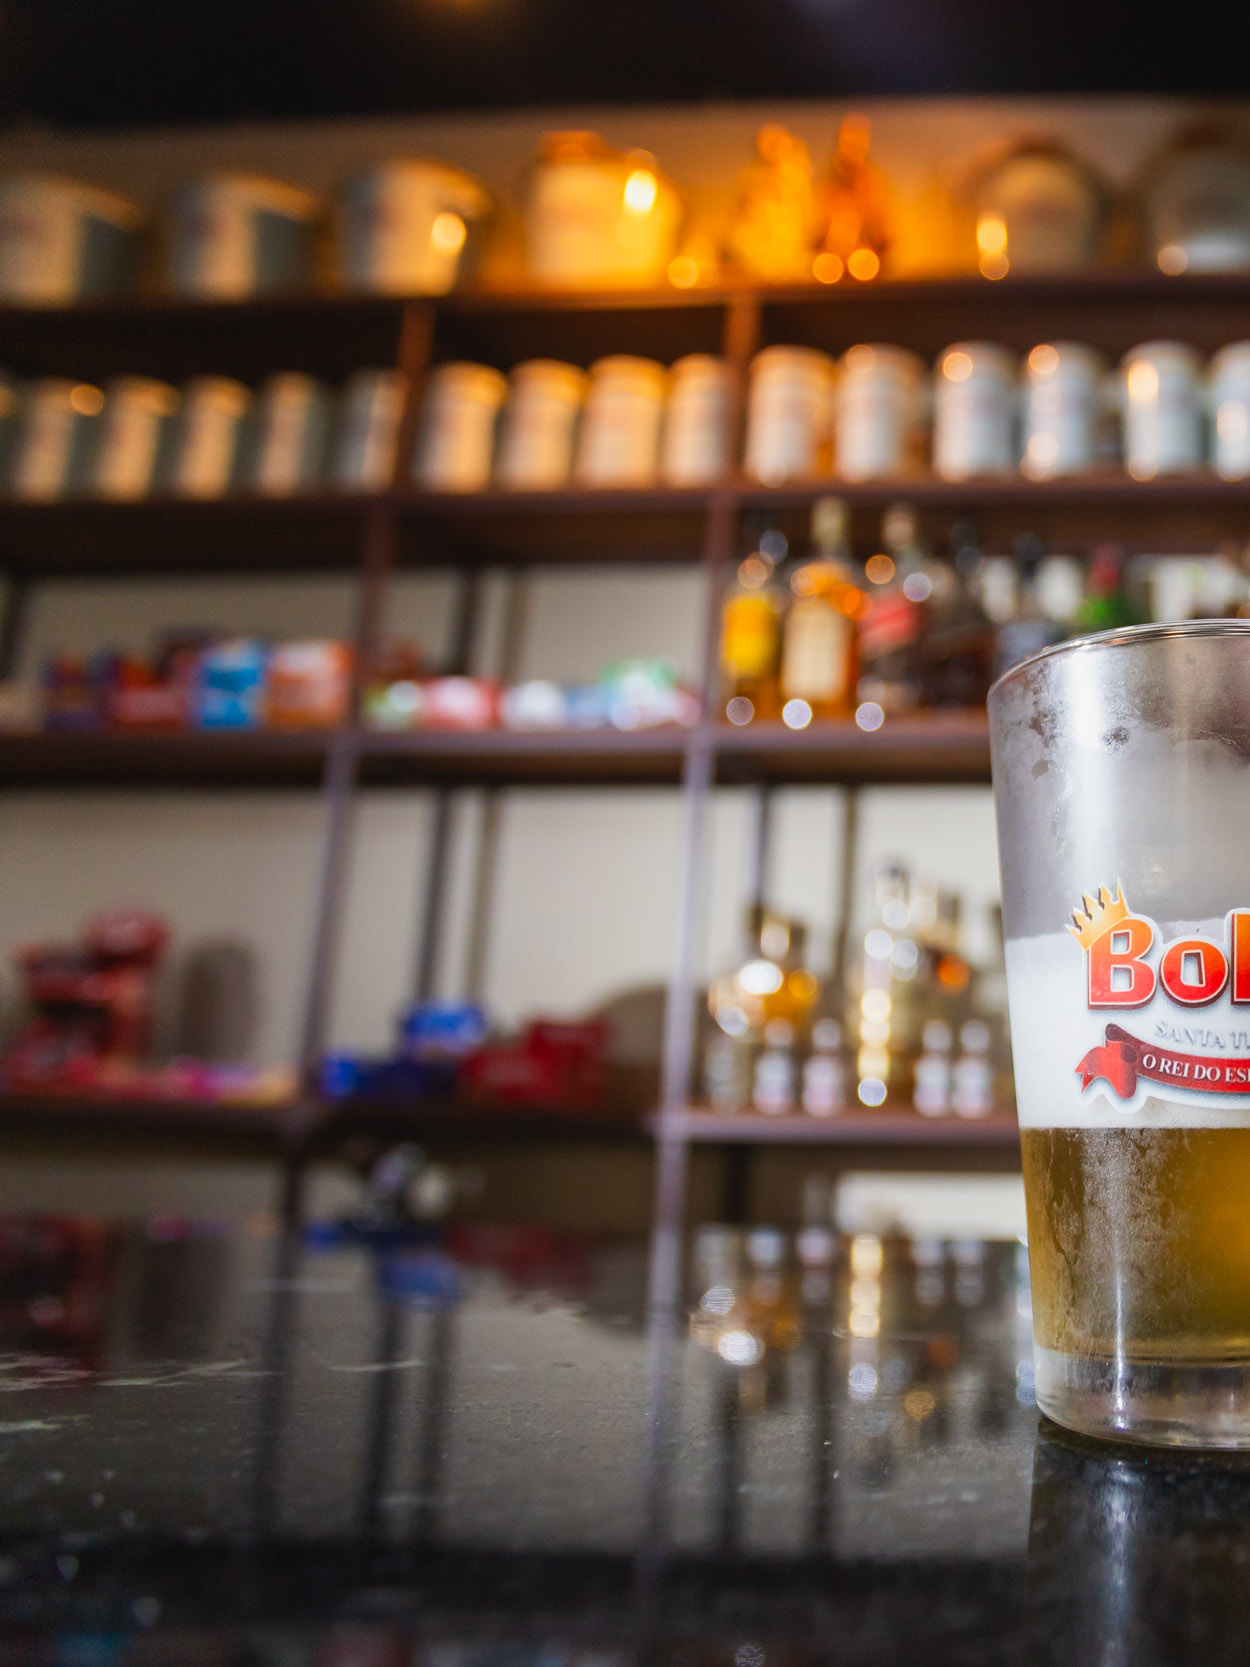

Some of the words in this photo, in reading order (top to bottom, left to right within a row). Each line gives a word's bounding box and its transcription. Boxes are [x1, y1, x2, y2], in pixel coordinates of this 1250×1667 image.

[1154, 1020, 1225, 1048] SANTA
[1142, 1054, 1157, 1069] O
[1159, 1059, 1190, 1077] REI
[1193, 1065, 1221, 1082] DO
